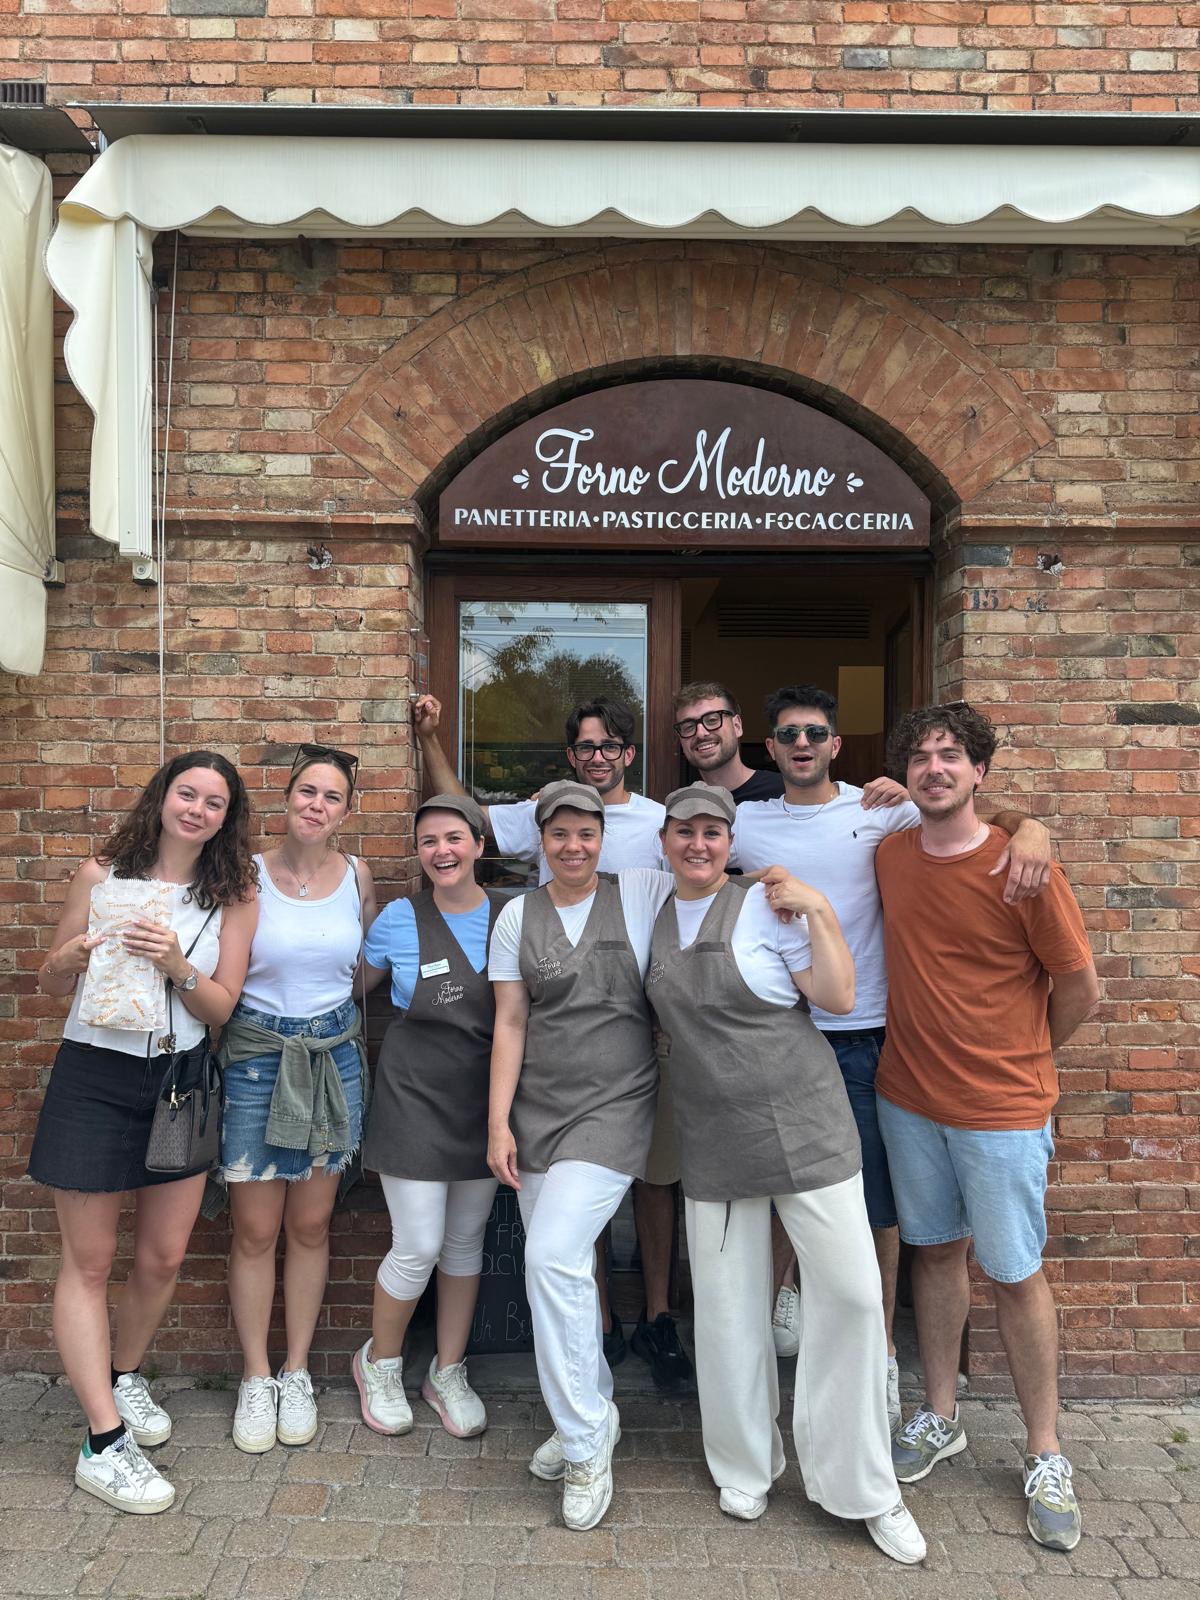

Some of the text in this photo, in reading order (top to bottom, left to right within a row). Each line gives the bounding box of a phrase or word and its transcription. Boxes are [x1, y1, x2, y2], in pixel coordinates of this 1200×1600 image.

[535, 426, 836, 500] Forno Moderno
[454, 508, 915, 531] PANETTERIA PASTICCERIA FOCACCERIA
[441, 980, 465, 995] Forno
[431, 991, 464, 1006] Moderno
